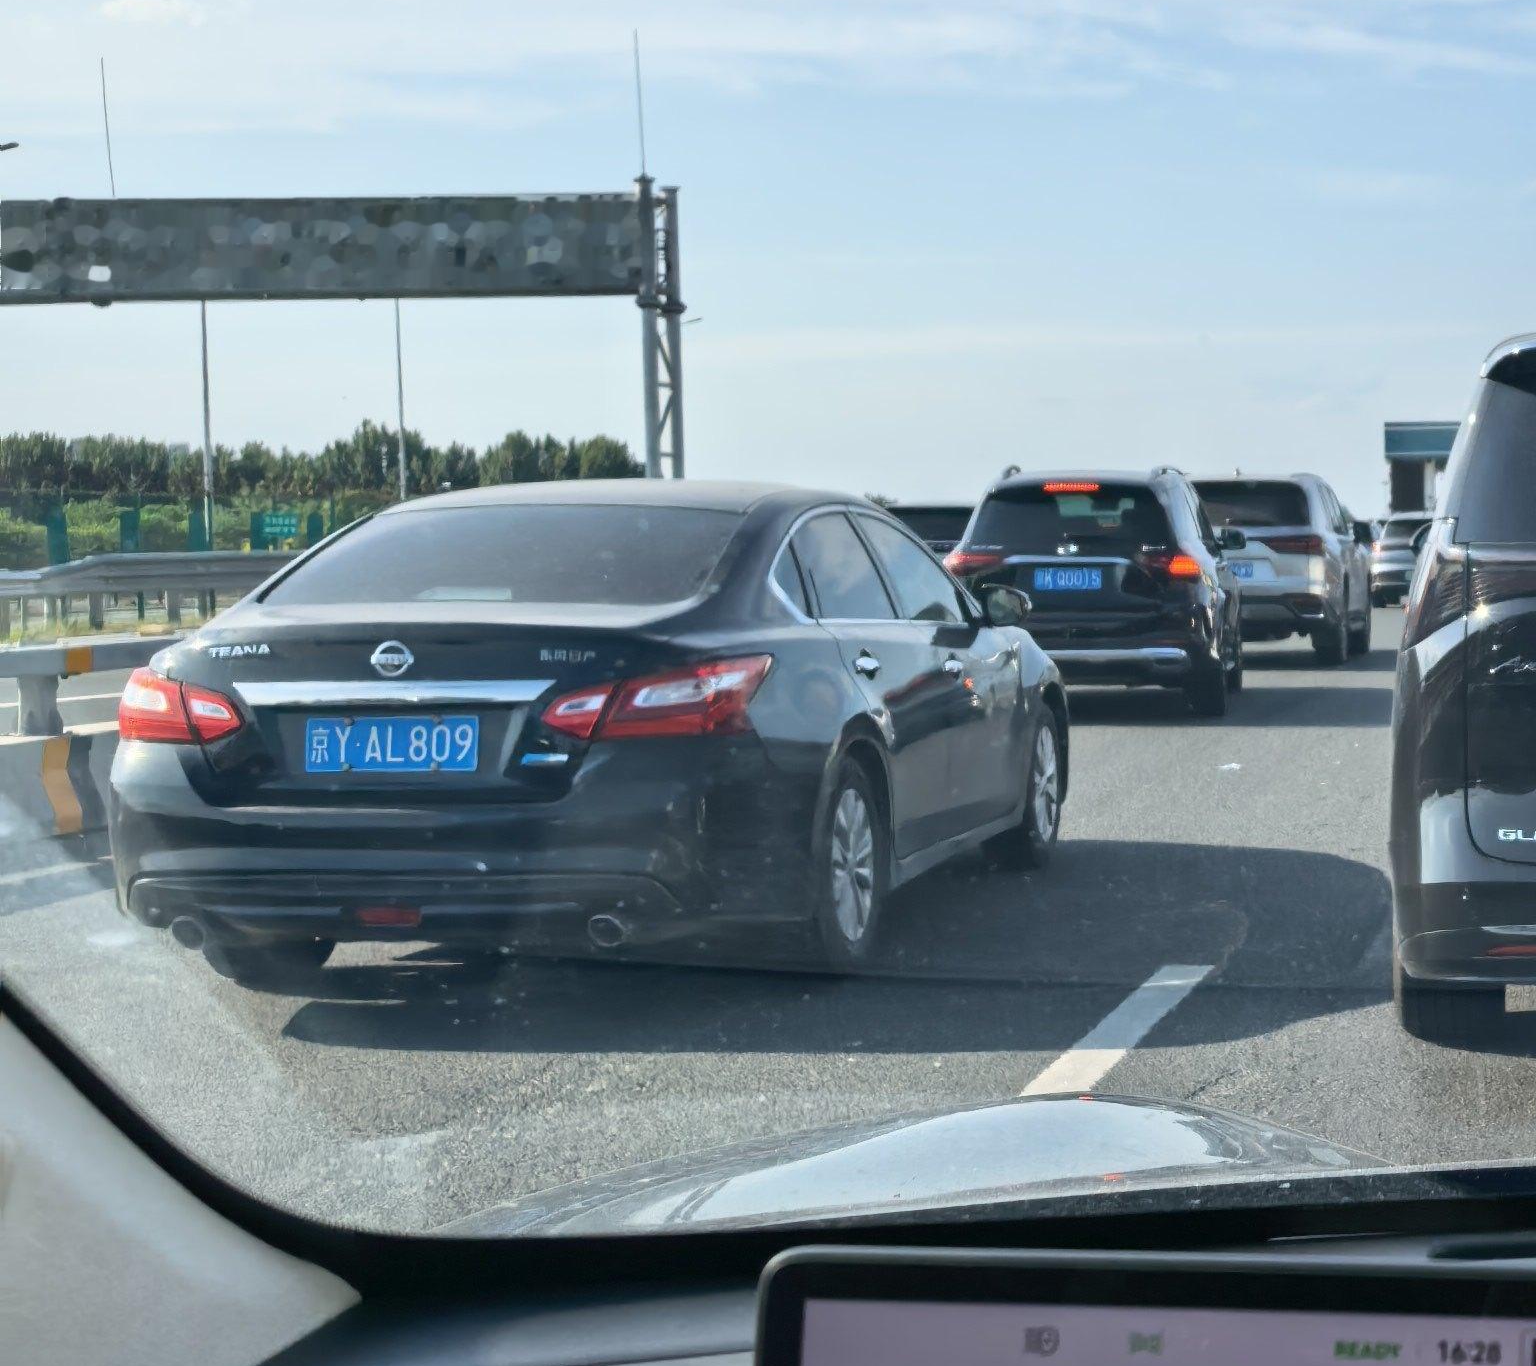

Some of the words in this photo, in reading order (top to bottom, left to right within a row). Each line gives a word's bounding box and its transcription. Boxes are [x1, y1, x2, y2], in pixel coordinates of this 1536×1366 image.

[209, 643, 271, 659] TEANA
[1334, 1339, 1402, 1361] READY
[1437, 1340, 1502, 1365] 16:28
